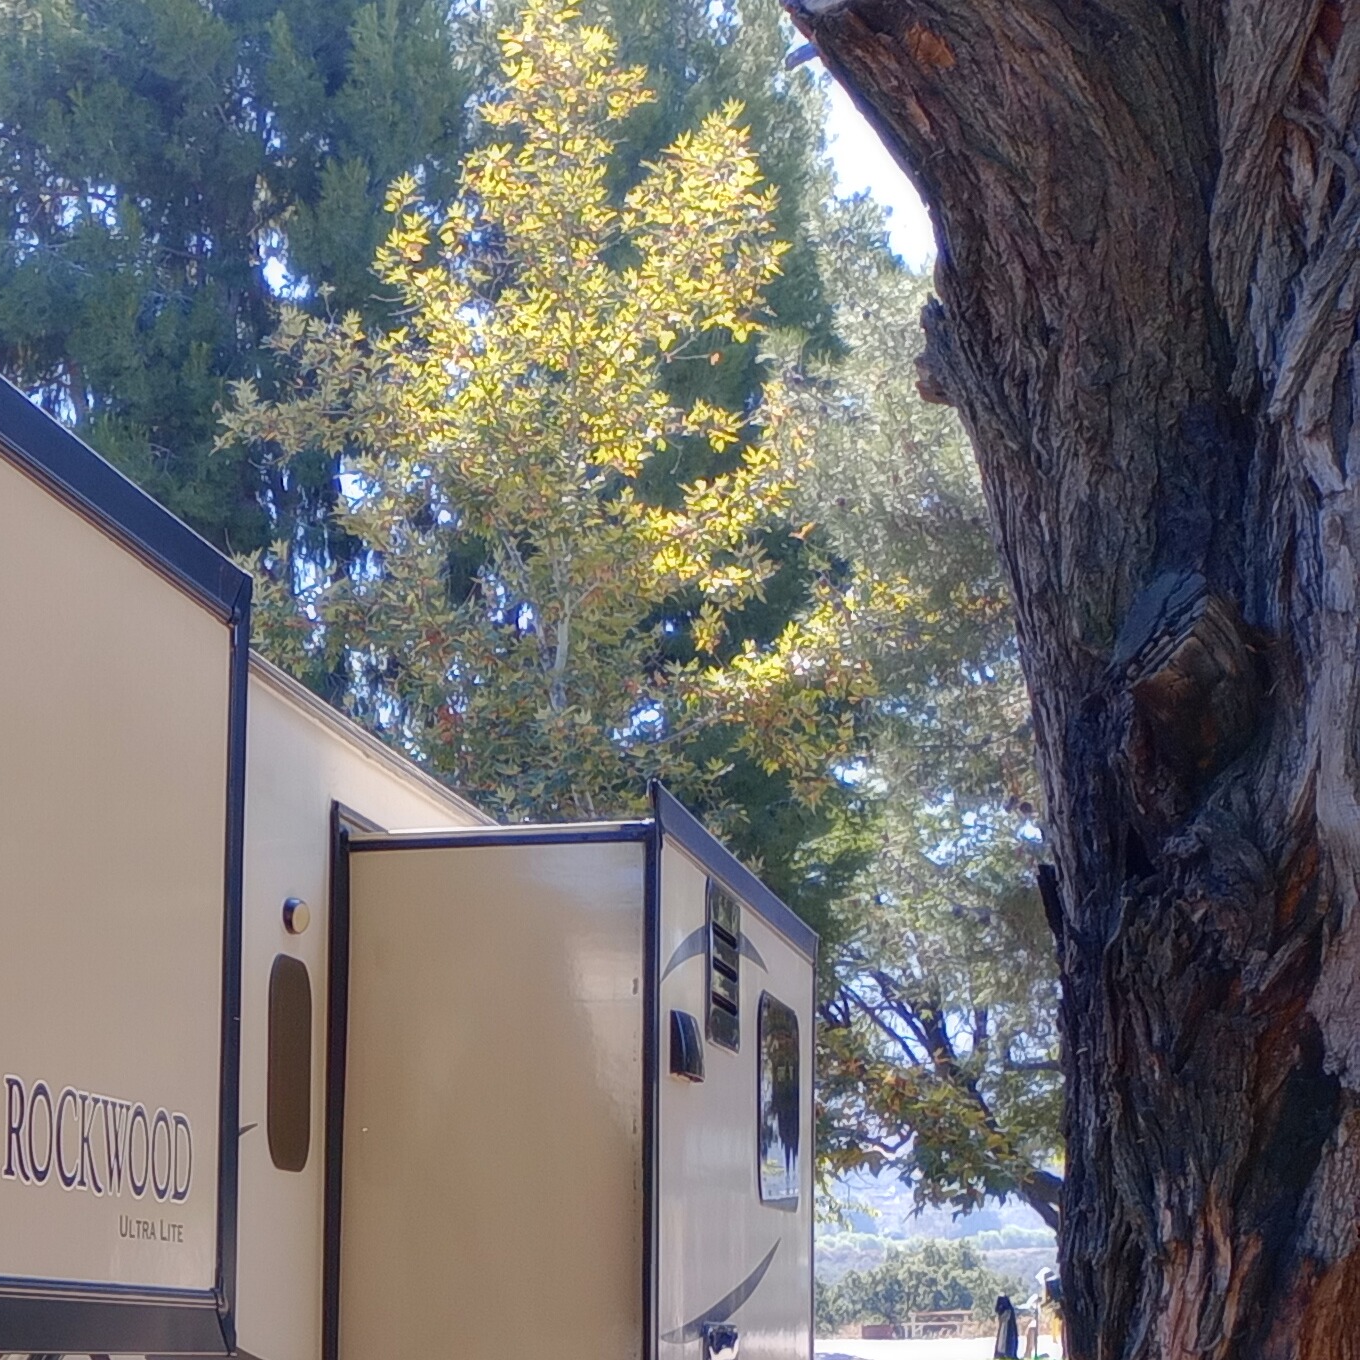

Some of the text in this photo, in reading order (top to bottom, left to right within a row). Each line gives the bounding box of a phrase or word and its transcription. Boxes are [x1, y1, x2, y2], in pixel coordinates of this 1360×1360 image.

[2, 1074, 193, 1204] ROCKWOOD
[118, 1214, 184, 1243] ULTRA LITE
